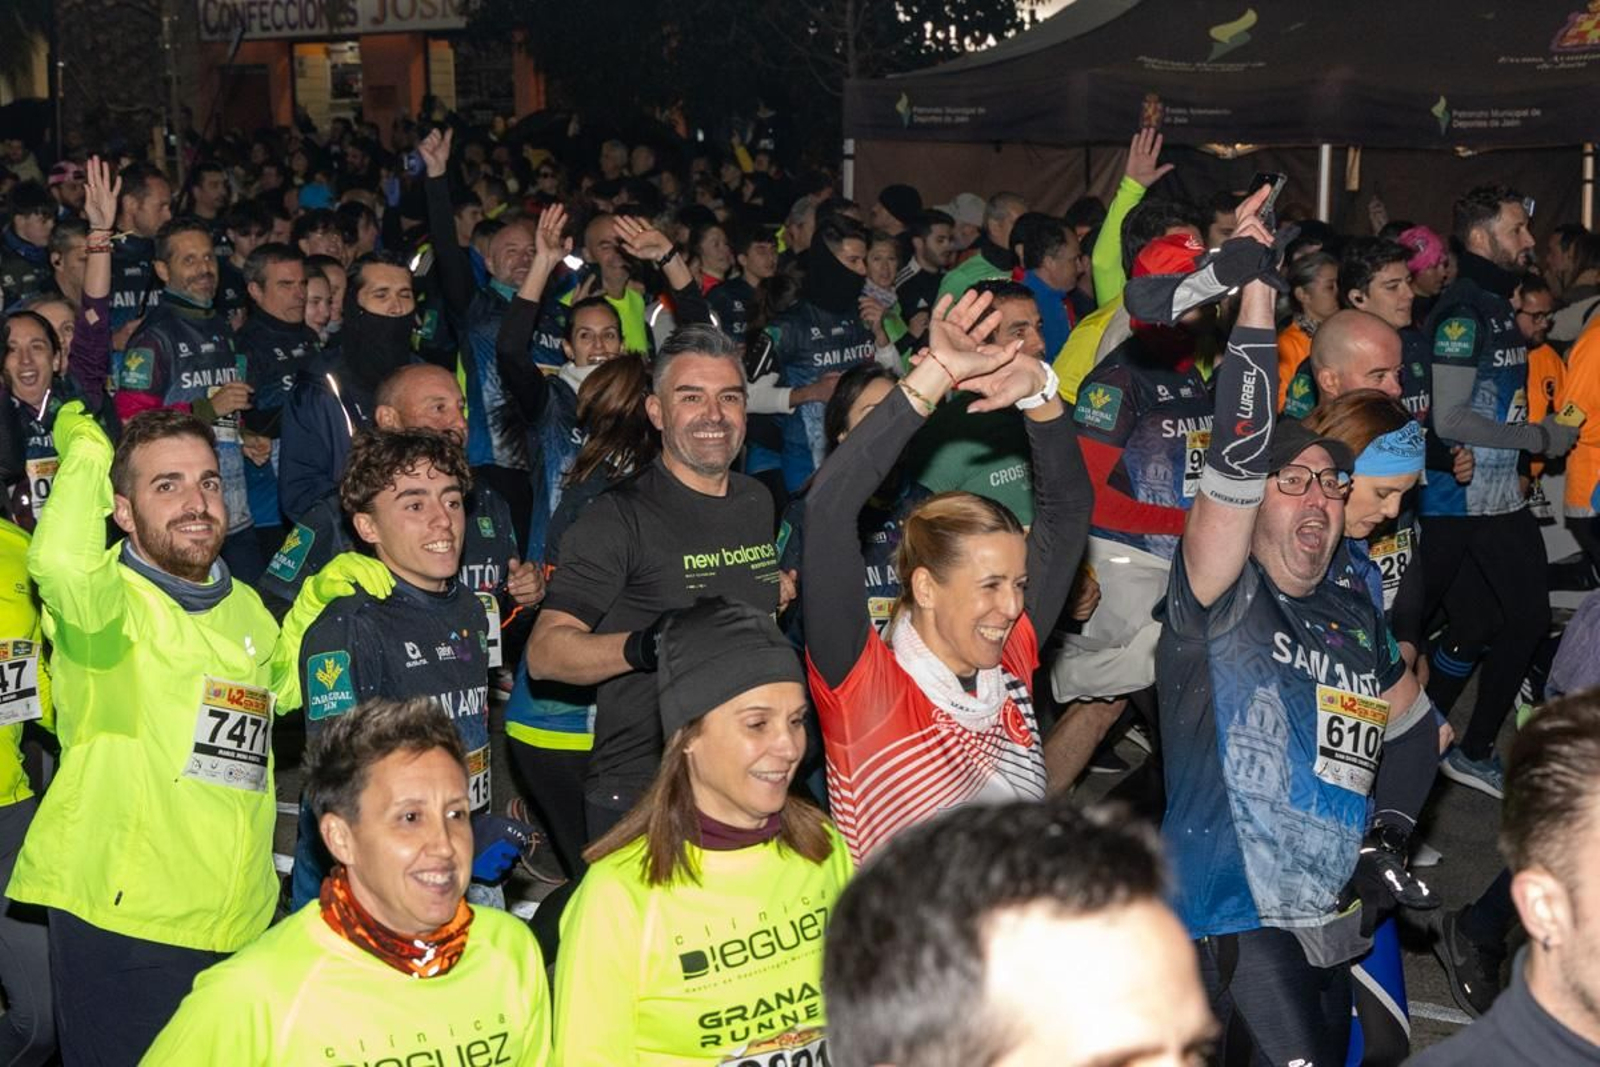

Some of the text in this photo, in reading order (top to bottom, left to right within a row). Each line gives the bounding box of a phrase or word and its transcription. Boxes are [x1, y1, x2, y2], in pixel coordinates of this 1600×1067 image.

[109, 290, 136, 308] AN
[180, 369, 212, 389] SAN
[1236, 368, 1257, 419] LURBEL
[1161, 417, 1198, 439] SAN
[683, 552, 720, 570] new
[721, 543, 775, 566] balance
[1380, 552, 1407, 580] 28
[1272, 631, 1330, 684] SAN
[207, 708, 269, 754] 7471
[1326, 715, 1385, 761] 610
[698, 982, 820, 1029] GRANA
[700, 1002, 819, 1048] RUNNE
